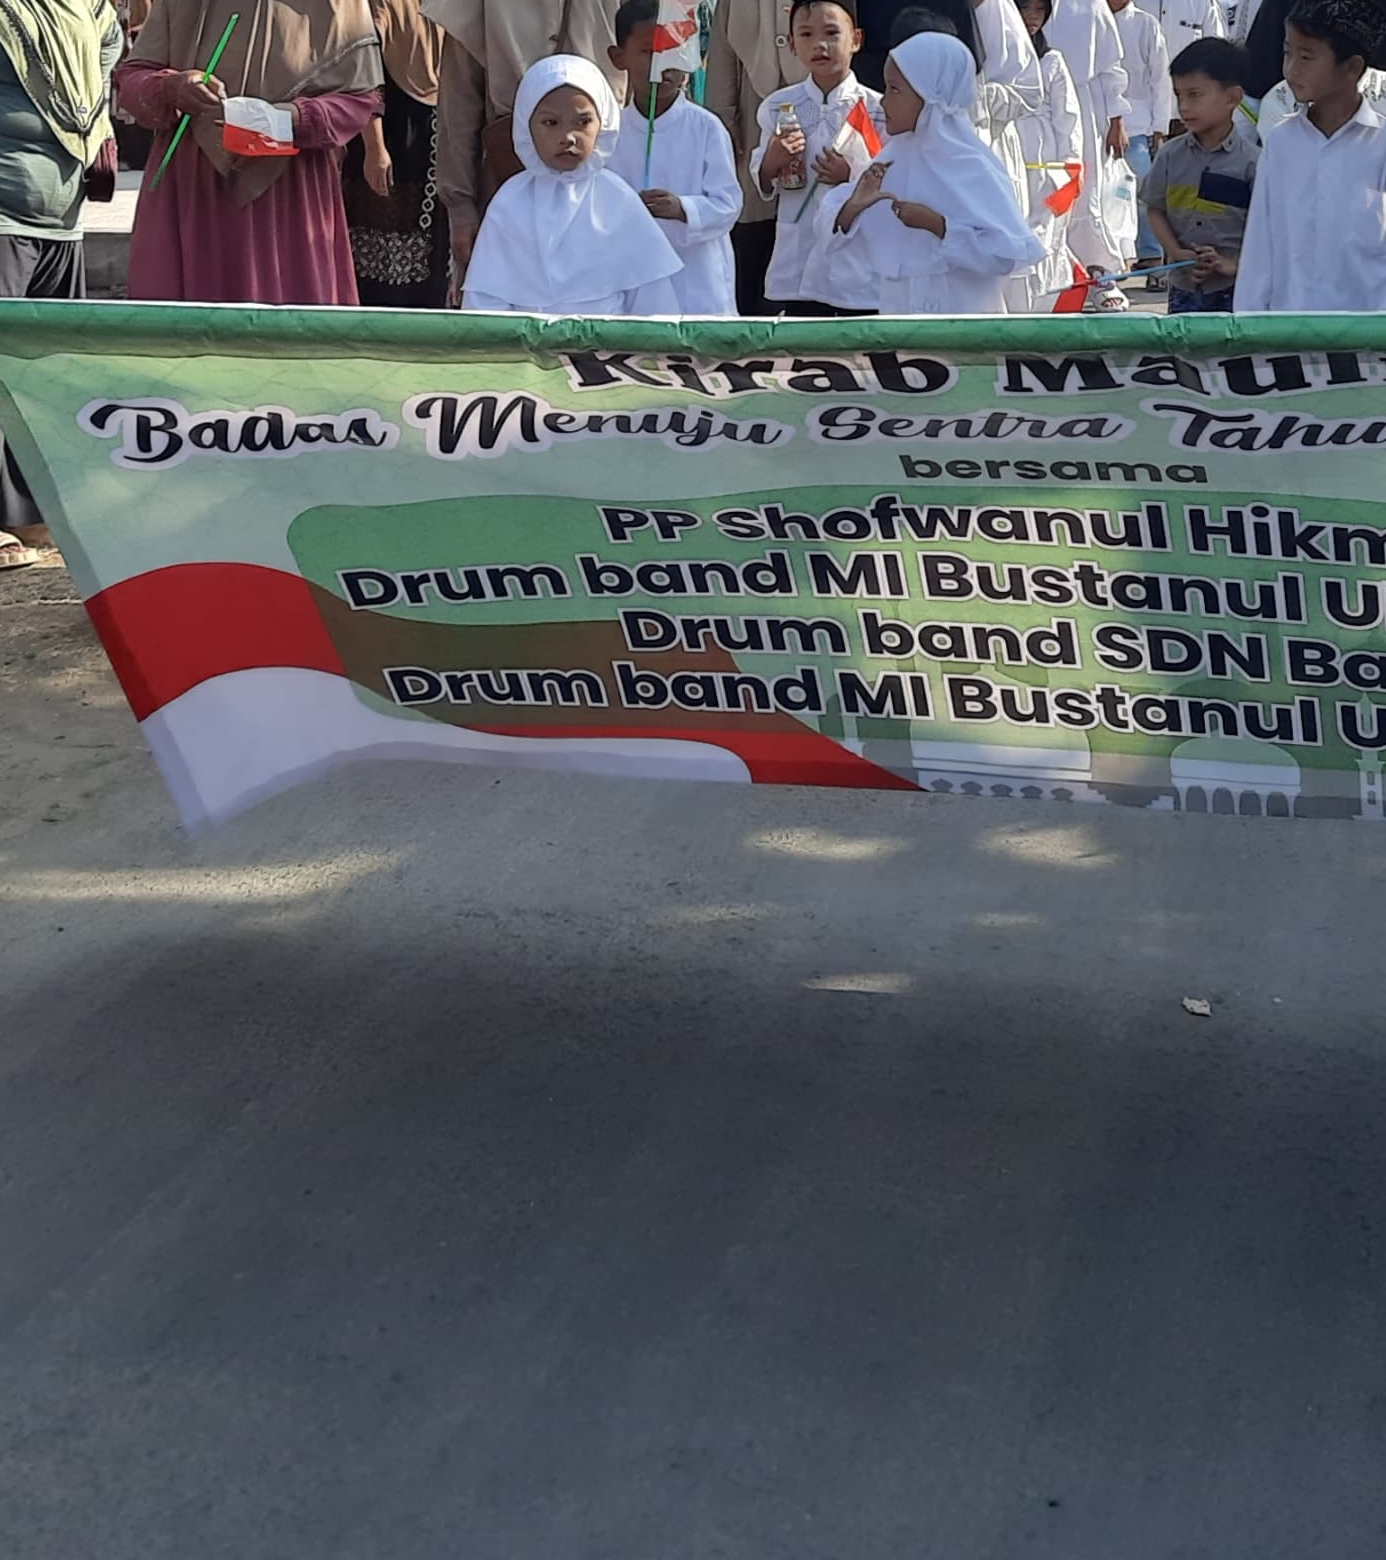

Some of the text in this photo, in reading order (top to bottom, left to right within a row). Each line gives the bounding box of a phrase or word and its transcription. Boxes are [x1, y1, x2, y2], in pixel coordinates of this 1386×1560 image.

[560, 351, 951, 396] Kirab
[89, 403, 387, 463] Badas
[415, 396, 782, 454] Menuju
[818, 406, 1124, 441] Sentra
[898, 455, 1209, 484] bersama
[603, 507, 697, 541] PP
[717, 496, 1167, 550] Shofwanul
[340, 565, 568, 607] Drum
[579, 552, 794, 596] band
[809, 551, 906, 598] MI
[920, 553, 1304, 622] Bustanul
[620, 610, 847, 653] Drum
[860, 611, 1079, 667] band
[1094, 624, 1268, 682] SDN
[386, 667, 607, 706] Drum
[614, 663, 823, 713] band
[837, 672, 933, 719] MI
[946, 678, 1320, 746] Bustanul
